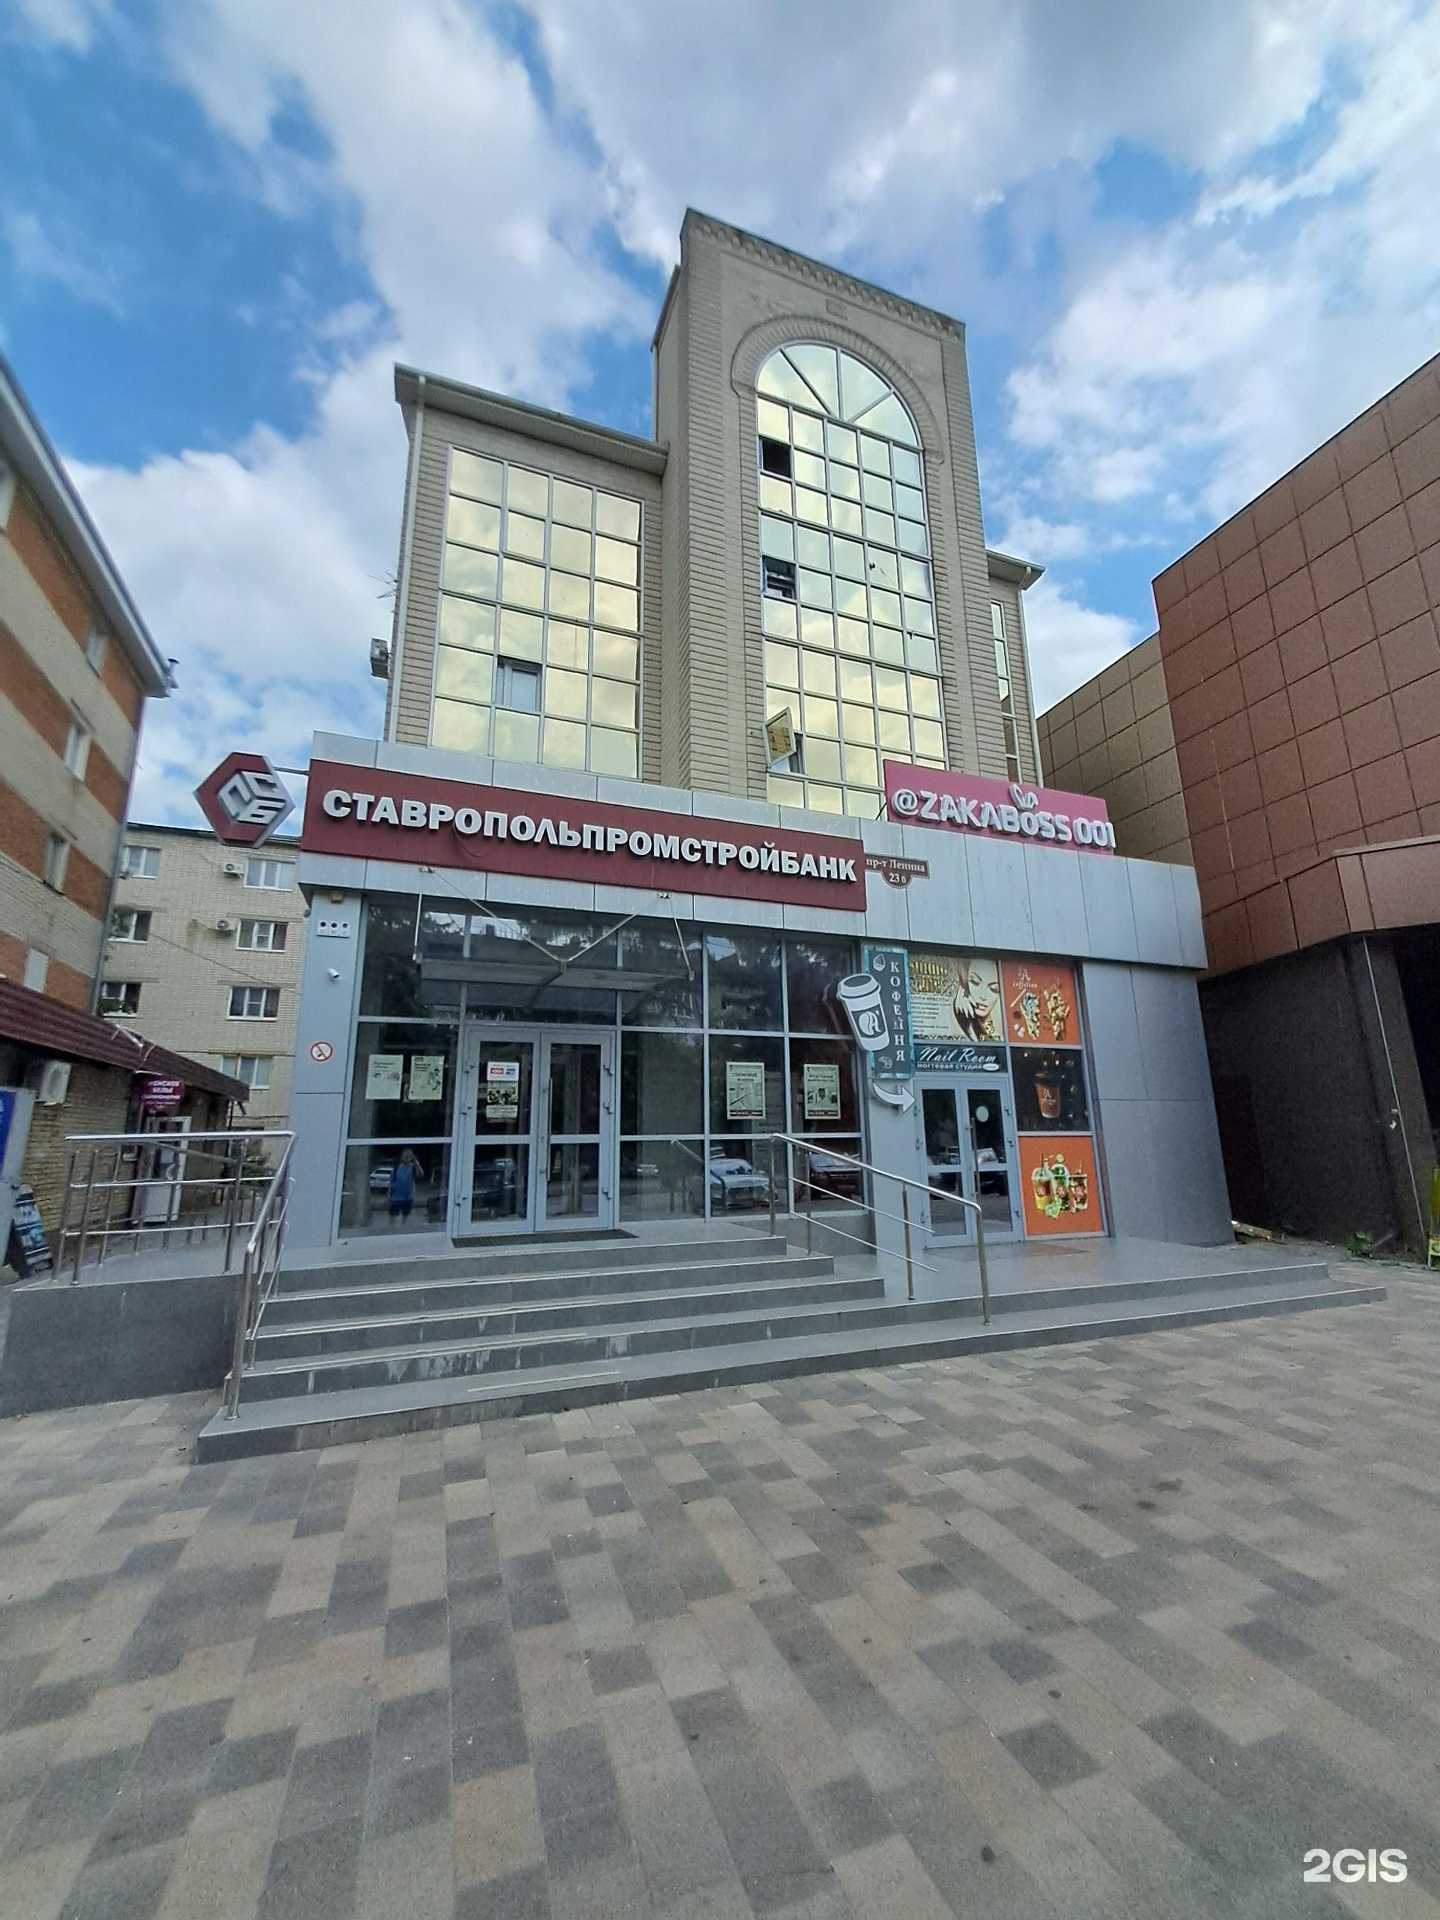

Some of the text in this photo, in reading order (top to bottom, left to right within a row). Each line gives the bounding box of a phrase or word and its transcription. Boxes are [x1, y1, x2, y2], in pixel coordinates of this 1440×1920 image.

[322, 789, 858, 883] СТАВРОПОЛЬПРОМСТРОЙБАНК
[1072, 817, 1117, 849] 001
[866, 858, 926, 873] пр-т Ленина
[889, 961, 905, 1062] КОФЕЙНЯ
[919, 1046, 997, 1063] Nail Room
